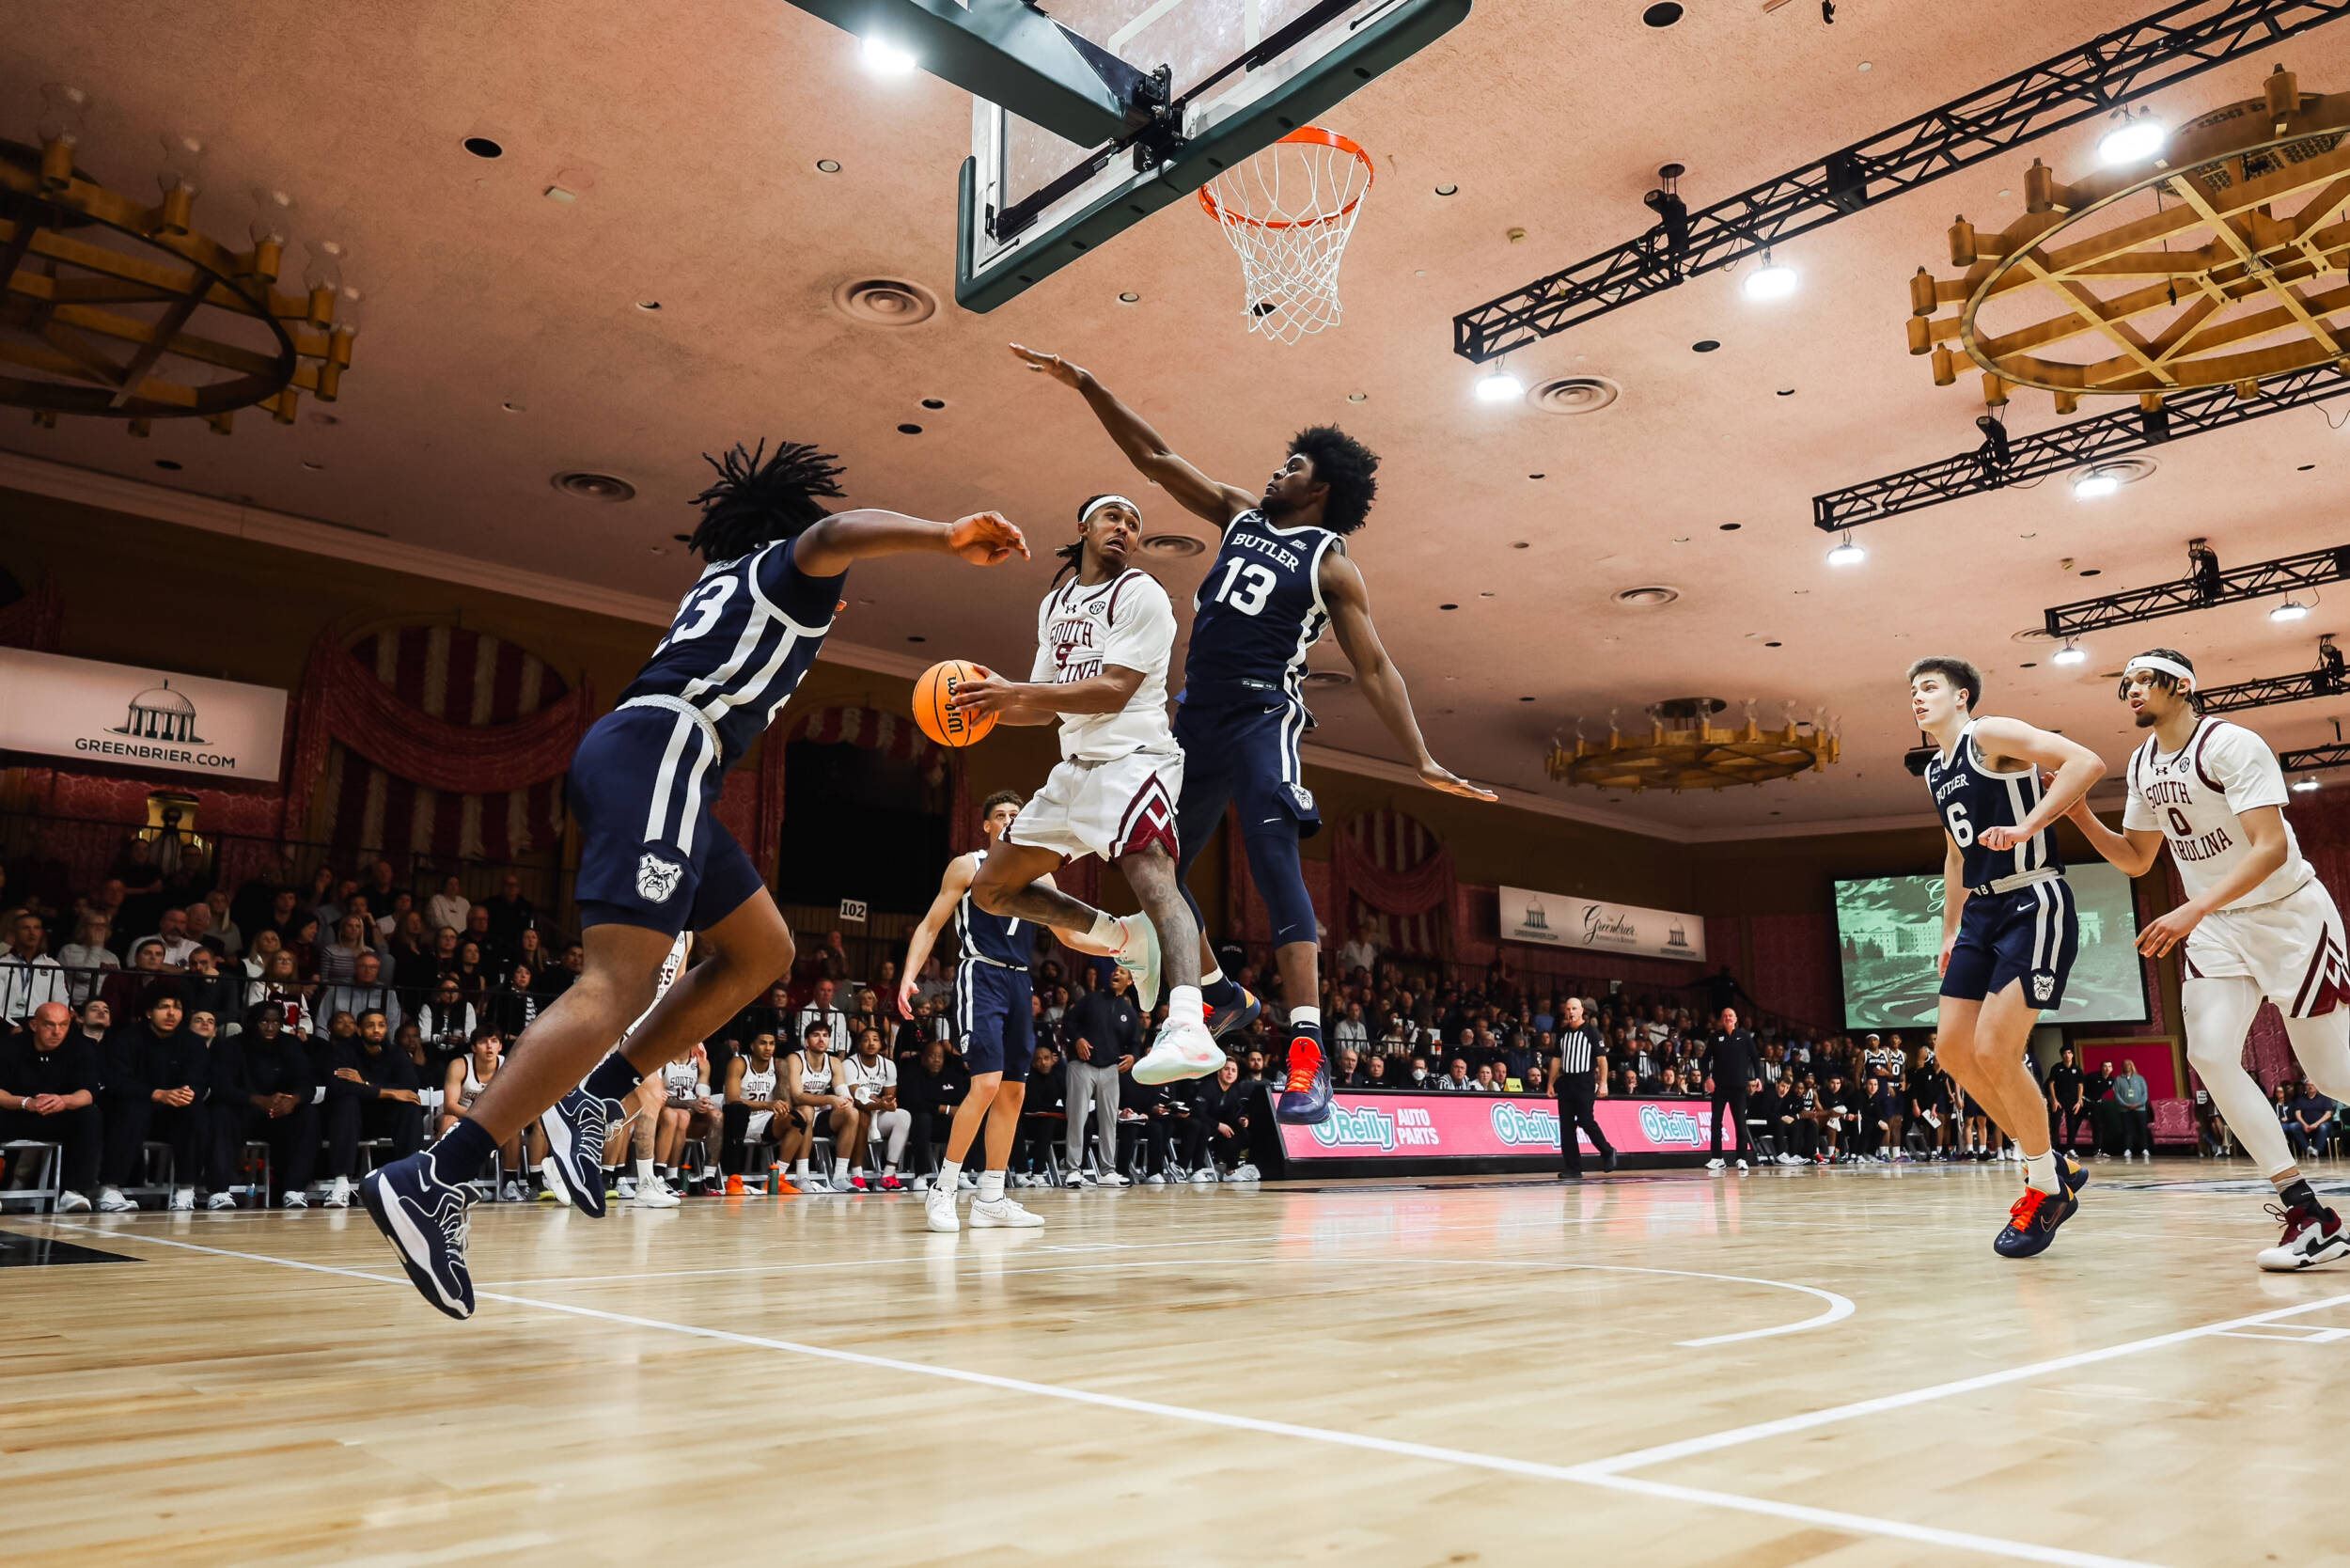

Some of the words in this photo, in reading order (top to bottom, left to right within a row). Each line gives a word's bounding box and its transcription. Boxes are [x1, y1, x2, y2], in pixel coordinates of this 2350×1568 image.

[1230, 533, 1300, 573] BUTLER
[1214, 556, 1277, 616] 13
[945, 675, 964, 734] Wilon
[75, 737, 236, 769] GREENBRIER.COM
[1935, 773, 1970, 806] BUTLER
[2146, 781, 2193, 809] SOUTH
[1946, 801, 1974, 848] 6
[2168, 808, 2192, 837] 0
[841, 902, 866, 918] 102
[746, 1081, 771, 1092] SOUTH
[1312, 1104, 1392, 1147] O'Reilly
[1397, 1108, 1432, 1126] AUTO
[1396, 1127, 1440, 1145] PARTS
[1494, 1106, 1560, 1145] O'Reilly
[1642, 1106, 1699, 1144] O'Reilly
